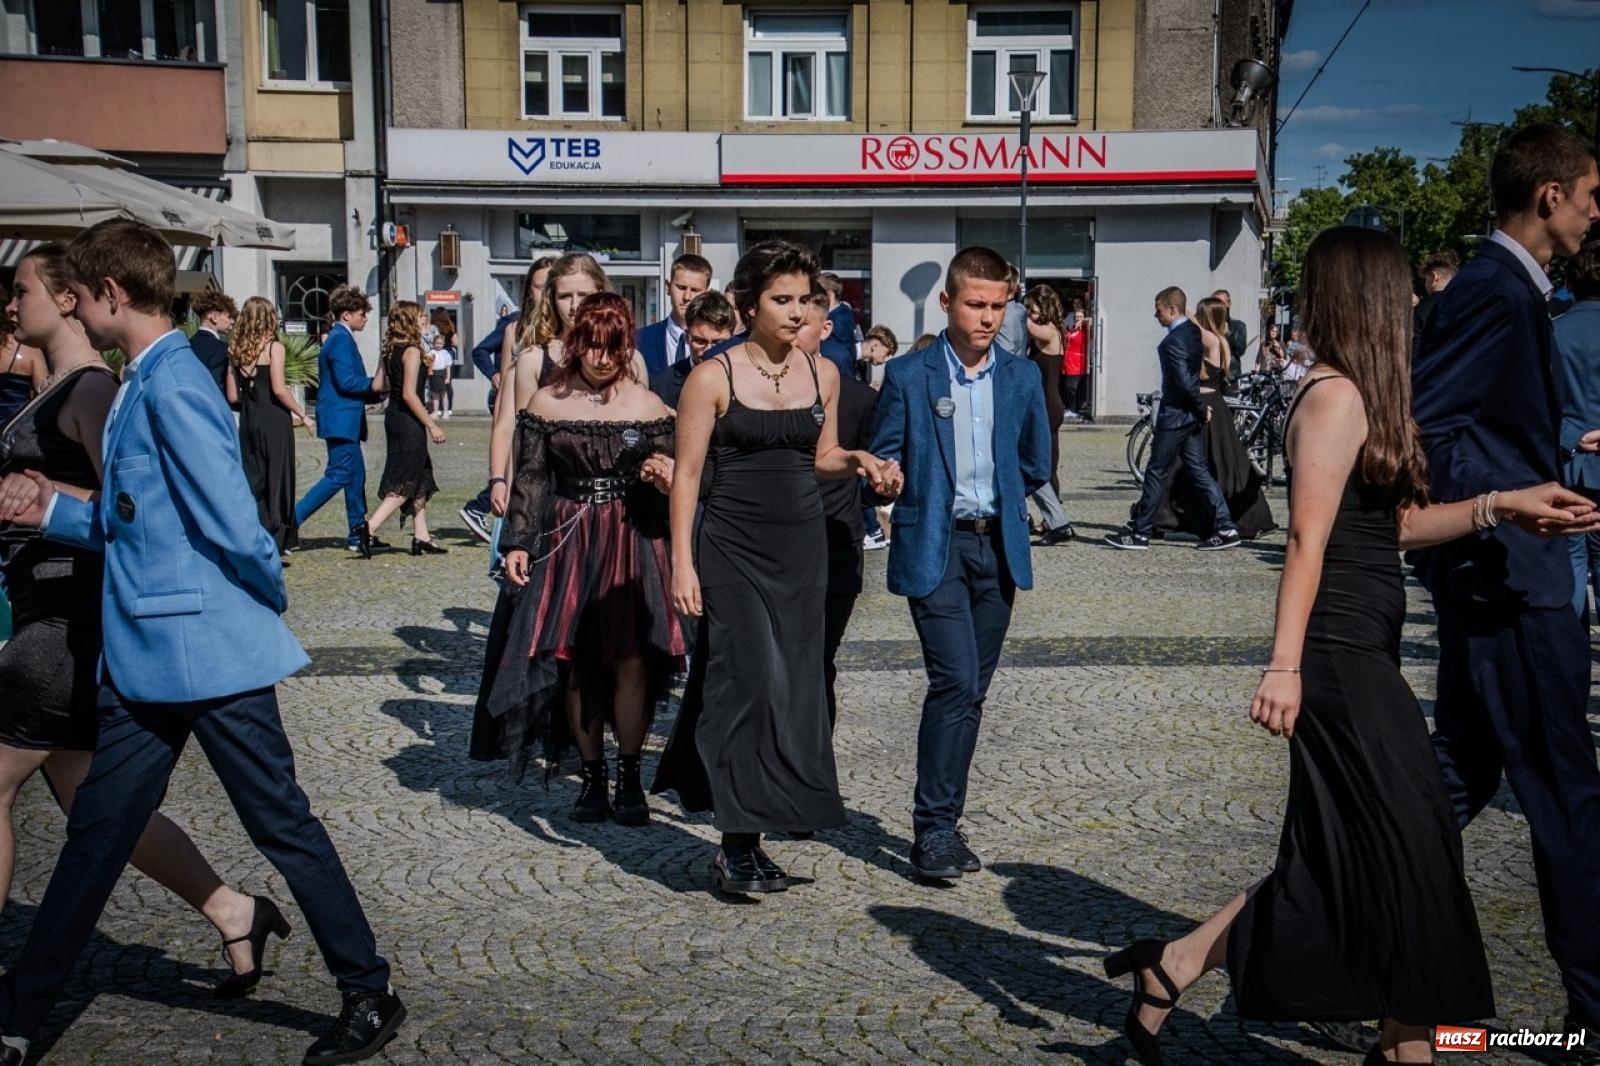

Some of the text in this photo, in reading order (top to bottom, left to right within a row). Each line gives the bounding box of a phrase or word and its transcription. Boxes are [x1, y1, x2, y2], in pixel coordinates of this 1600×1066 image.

[550, 138, 601, 157] TEB
[862, 135, 1107, 171] ROSSMANN
[549, 161, 602, 170] EDUKACJA
